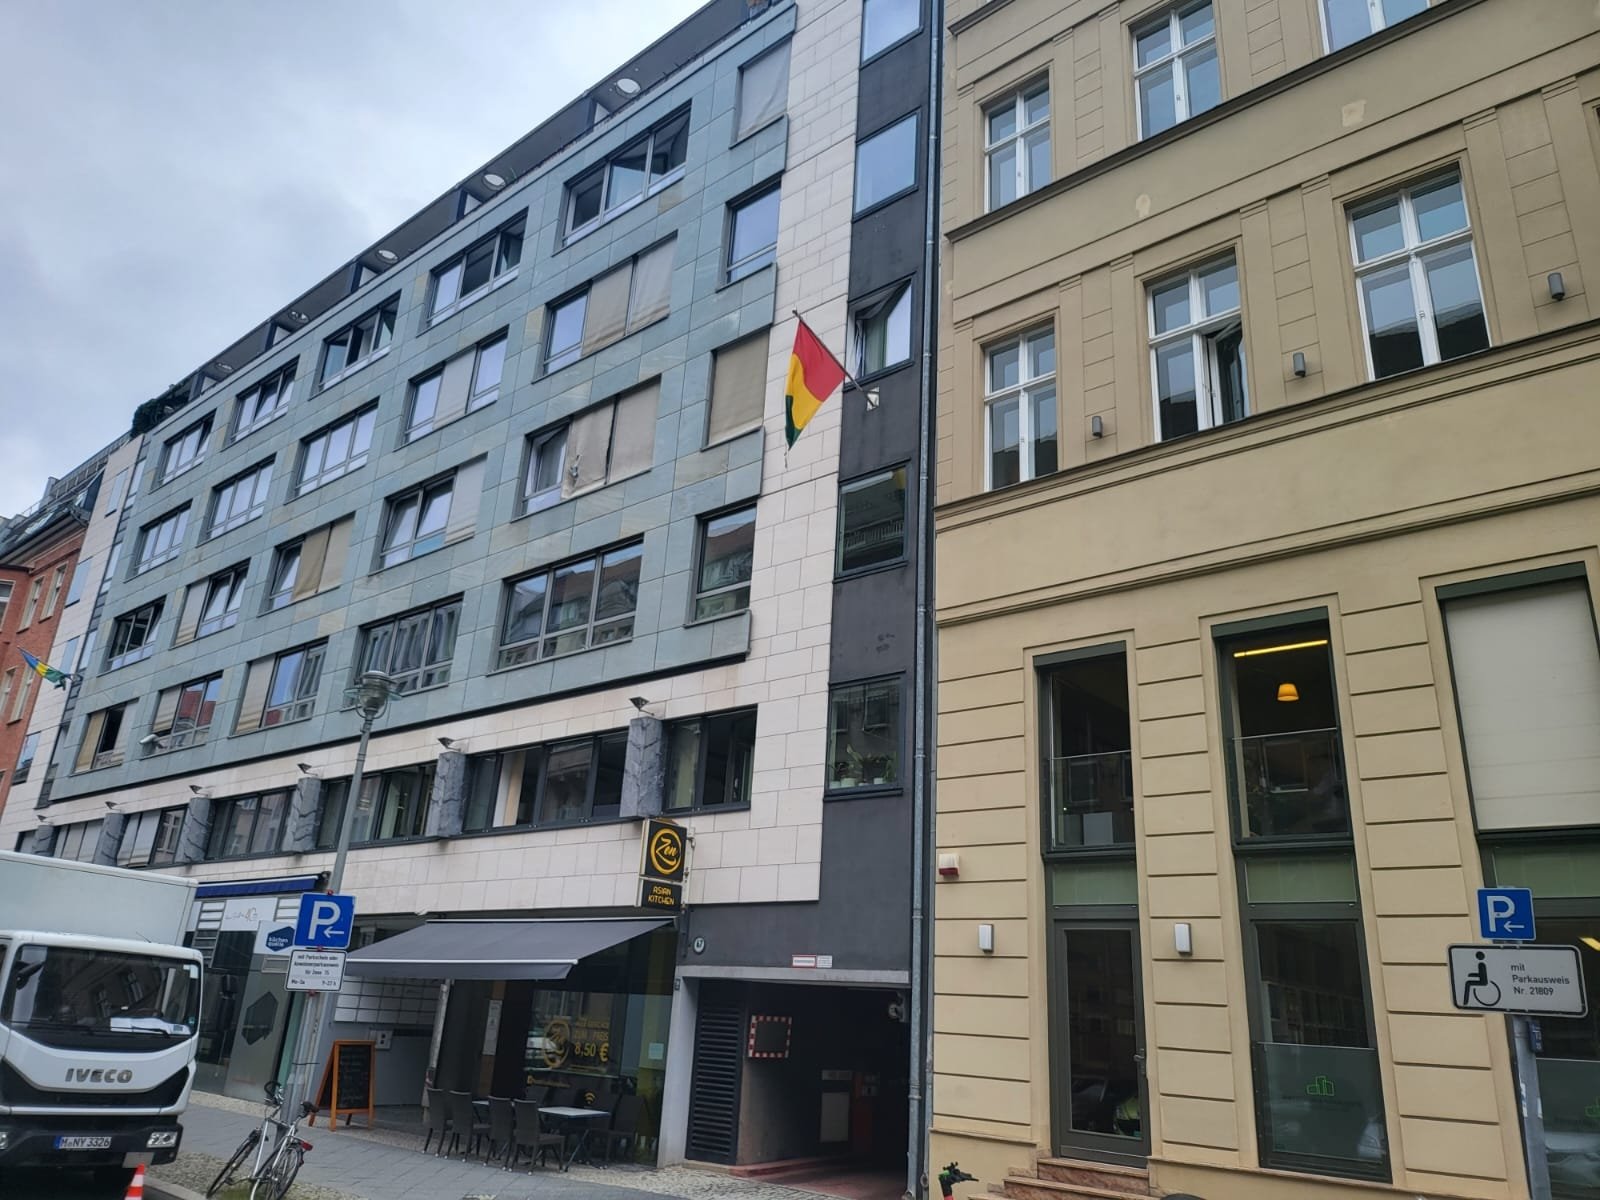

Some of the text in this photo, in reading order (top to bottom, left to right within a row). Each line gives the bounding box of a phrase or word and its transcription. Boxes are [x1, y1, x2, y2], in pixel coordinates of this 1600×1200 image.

[656, 837, 678, 866] Zen
[652, 886, 672, 895] ASIAN
[648, 896, 675, 905] KITCHEN
[1487, 896, 1515, 932] P
[308, 901, 340, 940] P
[1510, 963, 1526, 972] mit
[1512, 974, 1570, 985] Parkausweis
[1529, 986, 1554, 996] 21809
[575, 1042, 597, 1057] 8,50
[65, 1068, 133, 1084] IVECO
[86, 1138, 111, 1148] 3326
